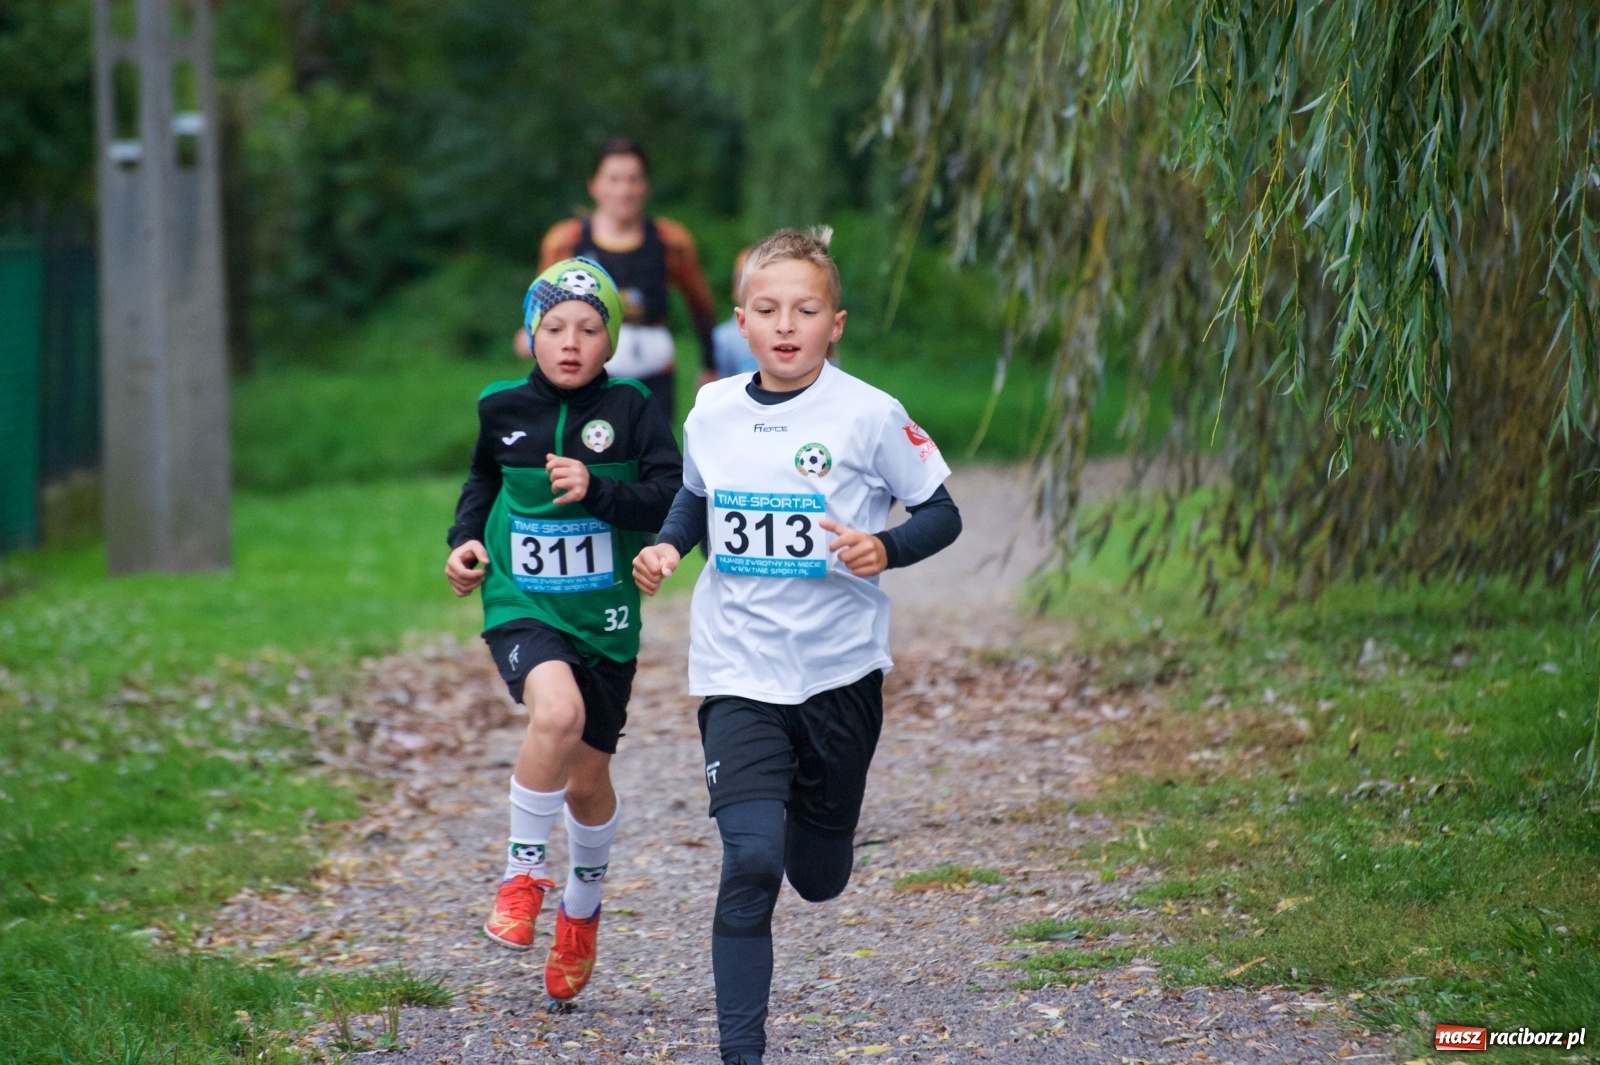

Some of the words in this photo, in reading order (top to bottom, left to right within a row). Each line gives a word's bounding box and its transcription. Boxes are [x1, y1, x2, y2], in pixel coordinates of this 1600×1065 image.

[717, 493, 822, 509] TIME-SPORT.PL
[514, 520, 607, 534] TIME-SPORT.PL
[724, 511, 814, 558] 313
[522, 536, 595, 576] 311
[719, 557, 745, 565] NUMER
[745, 558, 783, 567] ZWROTNY
[603, 605, 630, 632] 32
